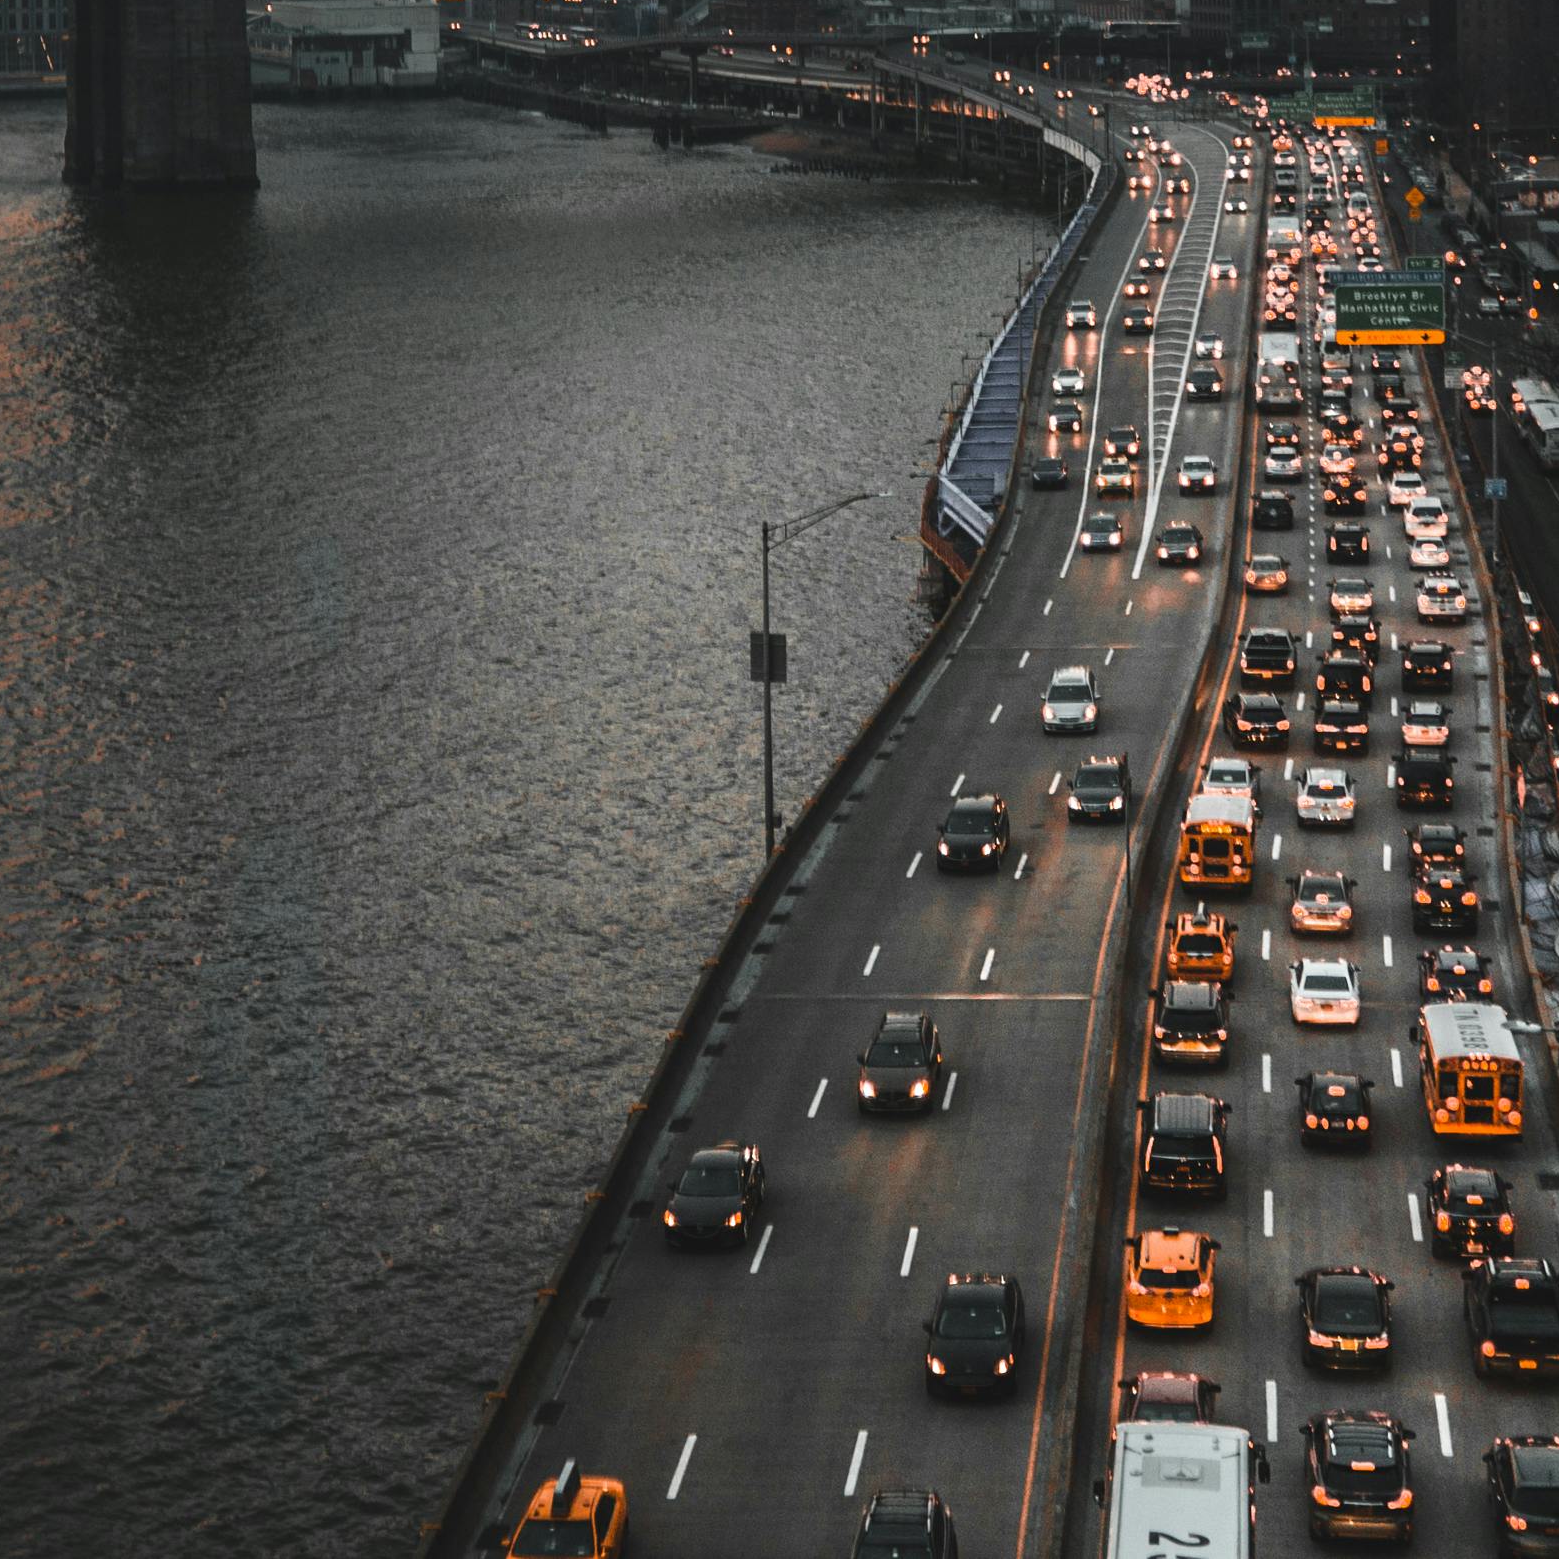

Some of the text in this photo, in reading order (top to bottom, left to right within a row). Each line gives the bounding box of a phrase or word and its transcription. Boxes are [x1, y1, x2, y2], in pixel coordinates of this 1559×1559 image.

[1432, 260, 1440, 268] 2
[1353, 290, 1425, 302] Brooklyn Br
[1339, 303, 1439, 313] Manhattan Civic
